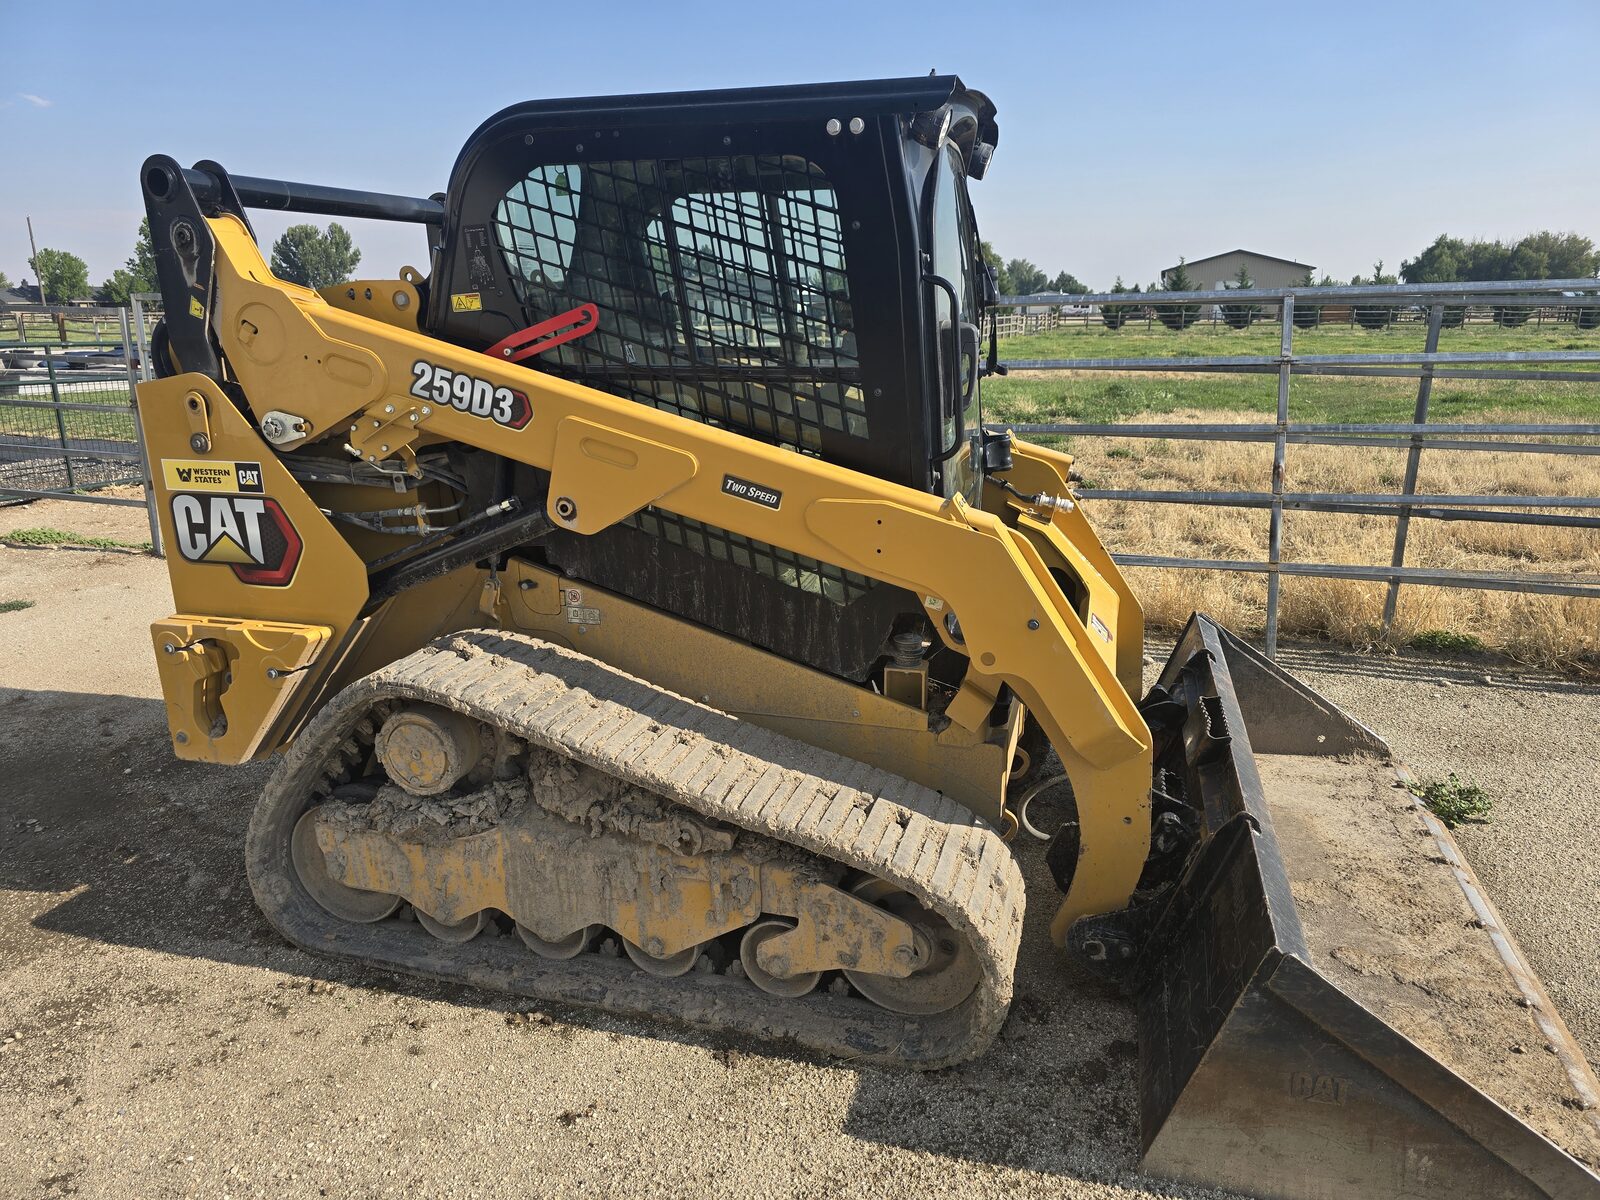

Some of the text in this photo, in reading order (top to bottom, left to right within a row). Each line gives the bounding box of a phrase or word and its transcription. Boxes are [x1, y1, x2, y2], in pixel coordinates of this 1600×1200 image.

[411, 362, 514, 423] 259D3
[192, 468, 231, 476] WESTERN
[194, 476, 222, 484] STATES
[238, 470, 259, 486] CAT
[172, 494, 265, 565] CAT
